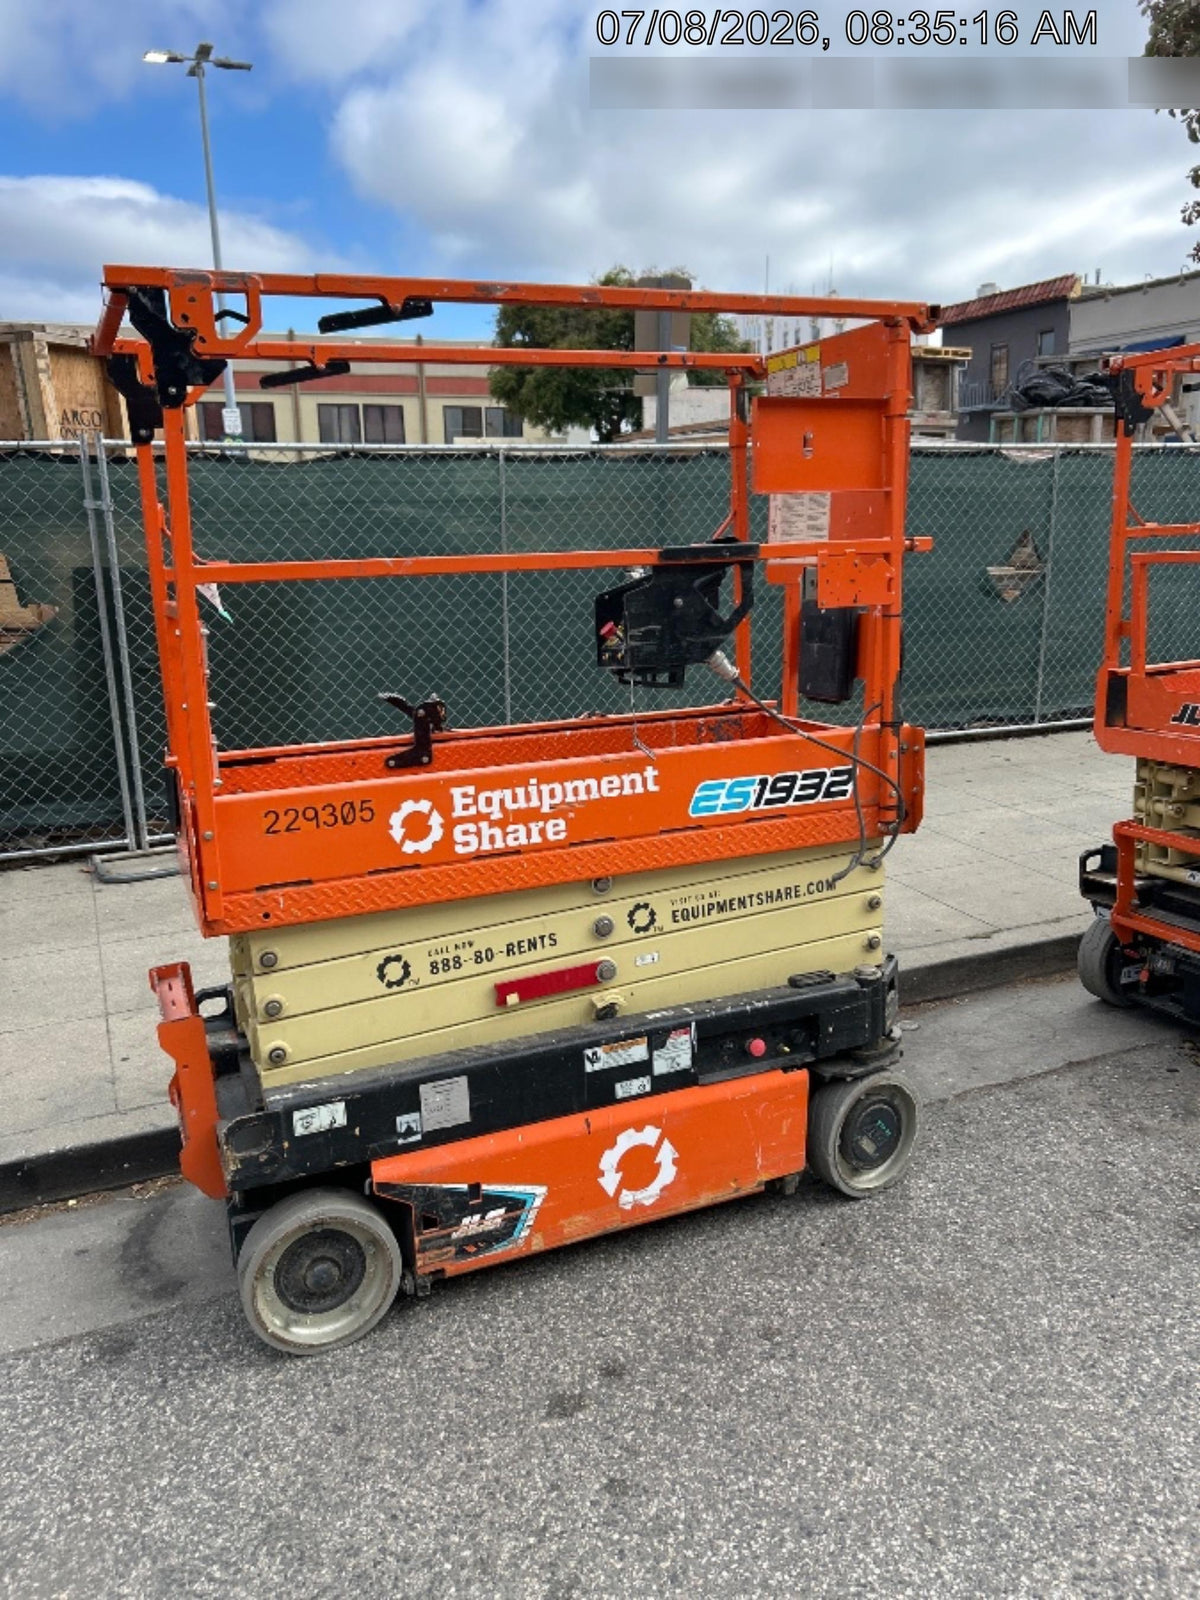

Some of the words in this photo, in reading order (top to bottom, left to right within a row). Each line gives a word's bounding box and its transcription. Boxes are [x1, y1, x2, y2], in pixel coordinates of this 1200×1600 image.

[60, 408, 103, 427] ARGO
[1168, 701, 1200, 727] JL
[450, 765, 661, 820] Equipment
[689, 765, 858, 818] ES1932
[263, 799, 376, 835] 229305
[452, 817, 568, 855] Share
[671, 879, 837, 924] EQUIPMENTSHARE.COM
[429, 932, 558, 976] 888-80-RENTS
